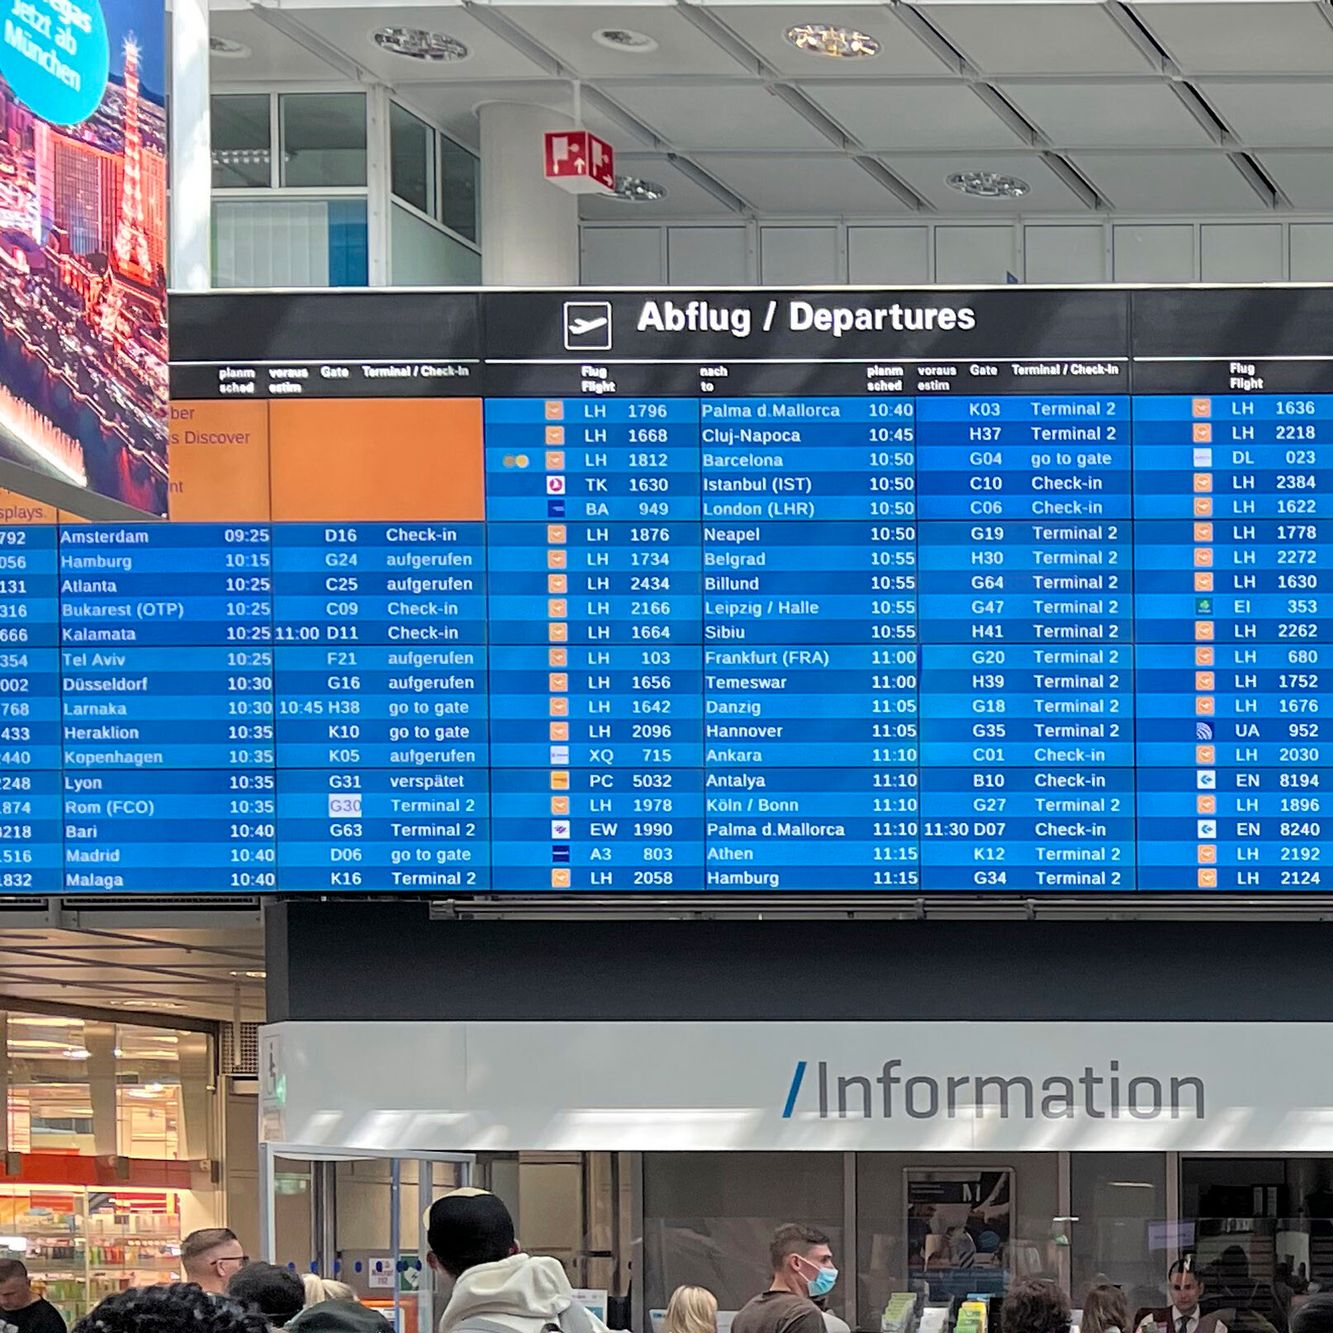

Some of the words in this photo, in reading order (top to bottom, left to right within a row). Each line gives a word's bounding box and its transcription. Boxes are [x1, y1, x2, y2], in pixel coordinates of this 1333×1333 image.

[4, 18, 81, 92] München
[636, 300, 751, 338] Abflug
[762, 300, 777, 332] /
[789, 300, 976, 337] Departures
[580, 365, 608, 380] Flug
[699, 365, 729, 377] nach
[866, 364, 904, 379] planm
[917, 366, 957, 376] voraus
[969, 363, 998, 376] Gate
[1011, 363, 1061, 376] Terminal
[1062, 363, 1069, 376] /
[580, 379, 616, 395] Flight
[700, 381, 715, 392] to
[866, 379, 903, 392] sched
[917, 379, 950, 391] estim
[584, 404, 606, 418] LH
[628, 404, 668, 418] 1796
[701, 403, 752, 418] Palma
[756, 403, 841, 418] d.Mallorca
[869, 403, 914, 417] 10:40
[969, 402, 1001, 417] K03
[1030, 401, 1101, 416] Terminal
[1106, 401, 1116, 416] 2
[185, 431, 250, 445] Discover
[1232, 450, 1255, 465] DL
[1285, 450, 1316, 465] 023
[585, 478, 608, 492] TK
[629, 478, 669, 492] 1630
[703, 477, 767, 492] Istanbul
[772, 476, 812, 494] (IST)
[870, 476, 915, 491] 10:50
[969, 476, 1003, 490] C10
[1031, 475, 1103, 490] Check-in
[1287, 599, 1318, 614] 353
[62, 627, 137, 642] Kalamata
[226, 626, 272, 641] 10:25
[275, 626, 320, 641] 11:00
[326, 626, 359, 640] D11
[387, 625, 459, 640] Check-in
[62, 676, 148, 692] Düsseldorf
[228, 676, 273, 691] 10:30
[327, 676, 361, 690] G16
[388, 675, 475, 693] aufgerufen
[64, 776, 103, 793] Lyon
[230, 775, 275, 790] 10:35
[329, 774, 362, 789] G31
[389, 774, 465, 791] verspätet
